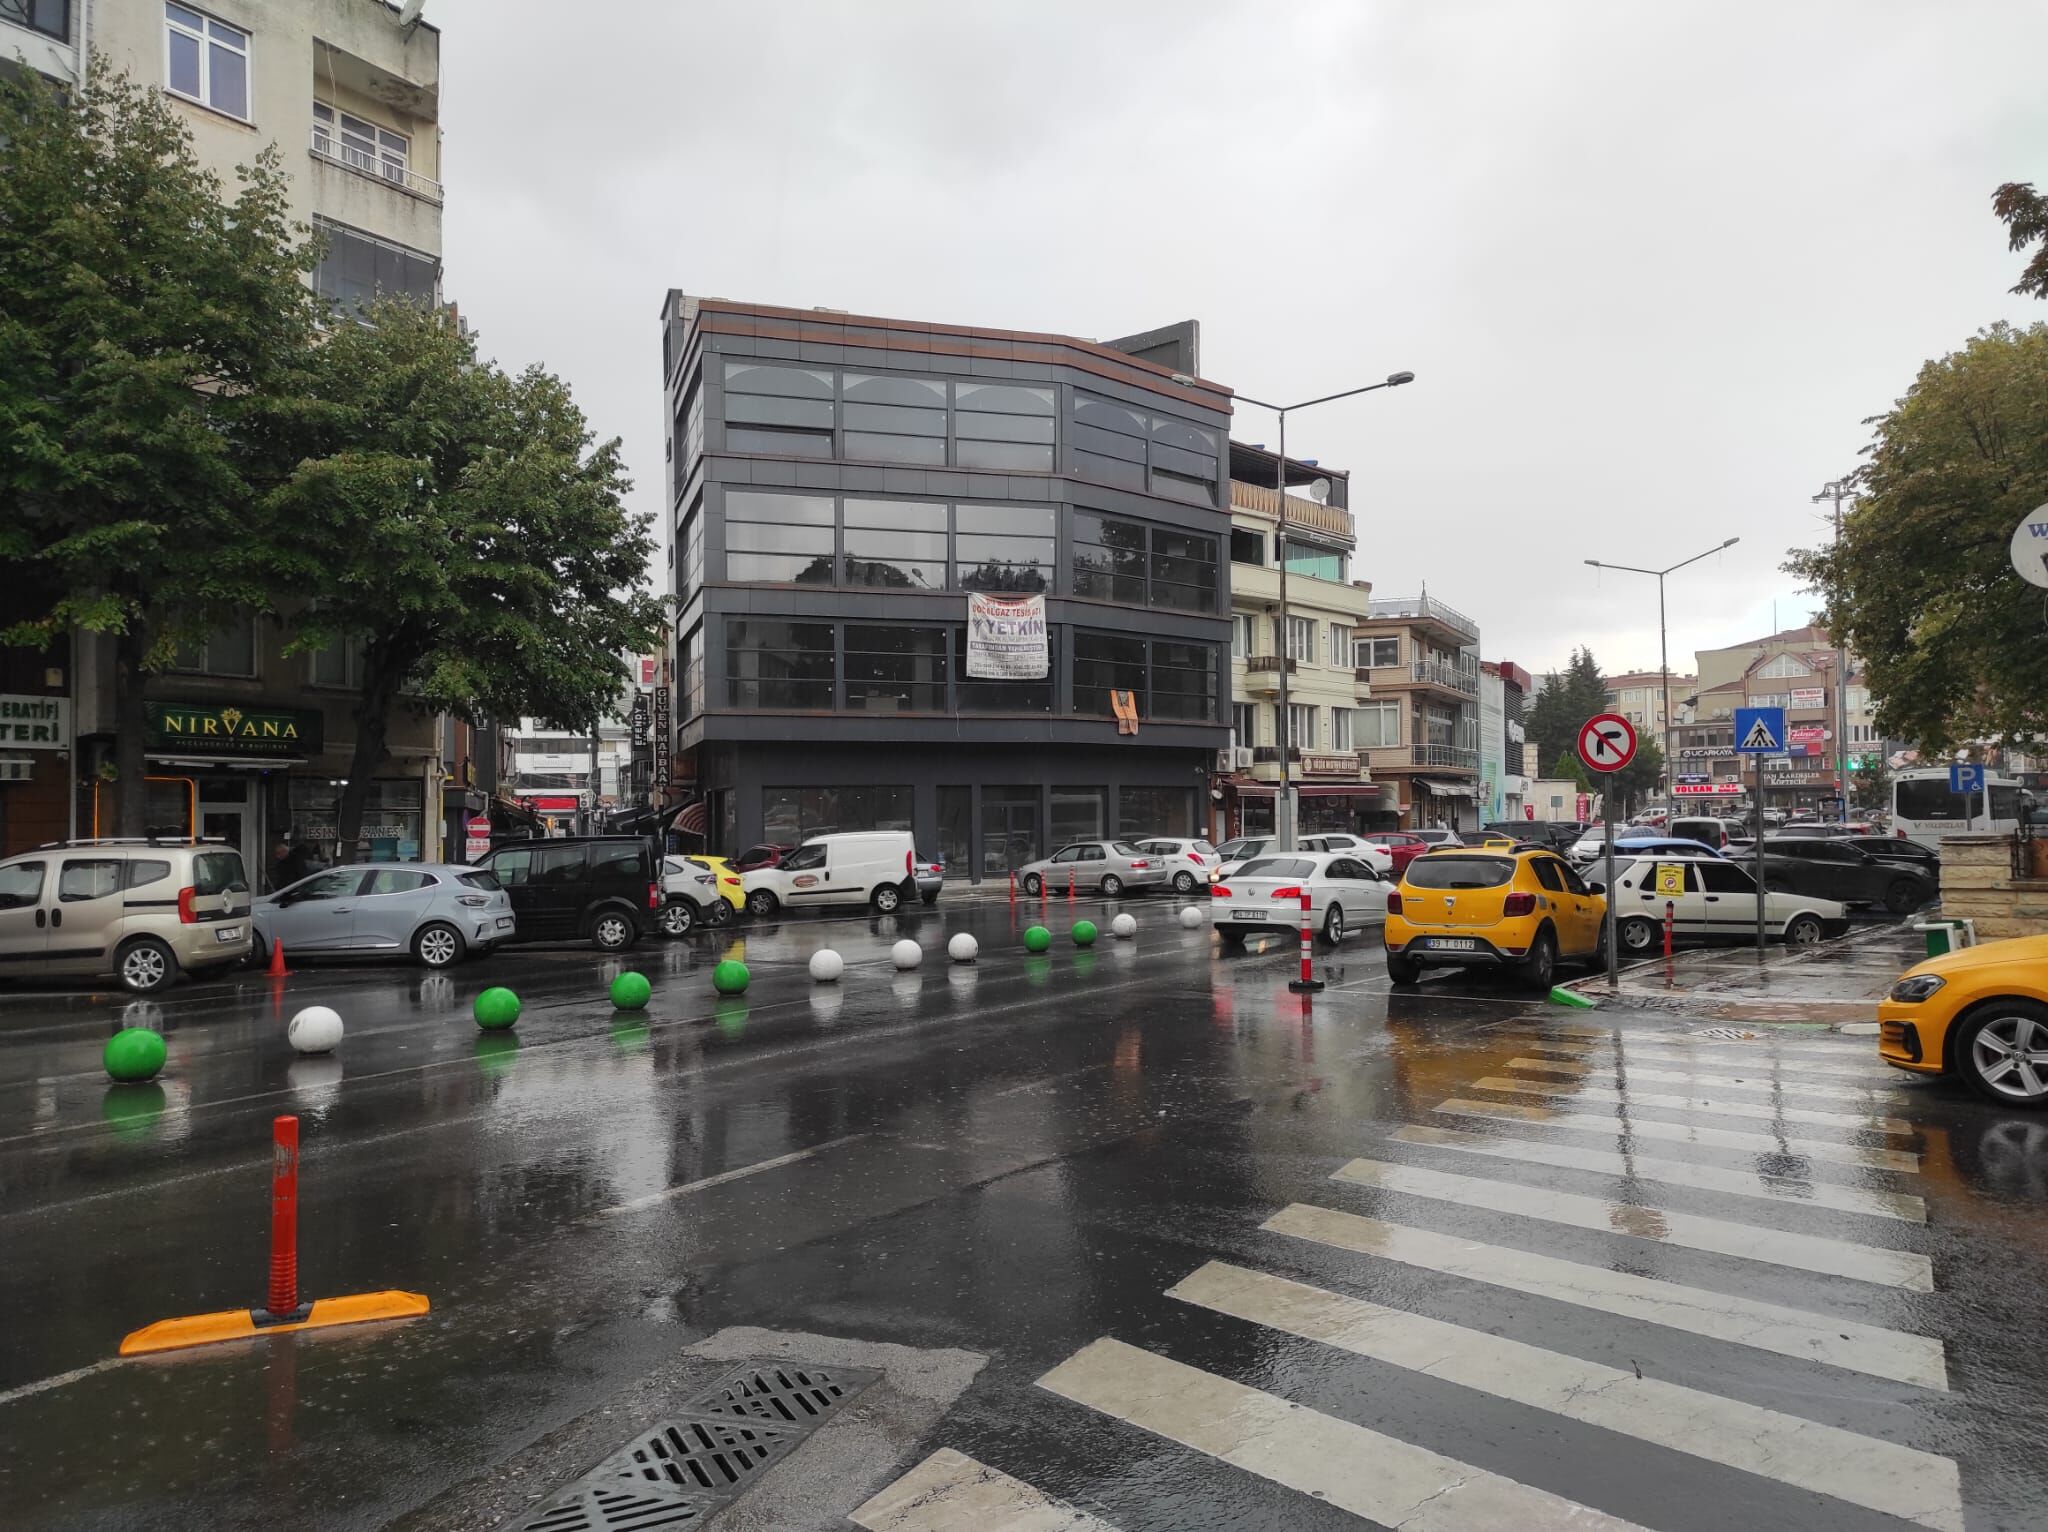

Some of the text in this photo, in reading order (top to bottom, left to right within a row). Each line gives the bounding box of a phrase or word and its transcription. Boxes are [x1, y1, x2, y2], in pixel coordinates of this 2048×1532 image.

[986, 617, 1043, 635] YETKİN
[164, 715, 298, 738] NIRVANA
[1957, 768, 1976, 791] P
[1454, 940, 1474, 949] 0112
